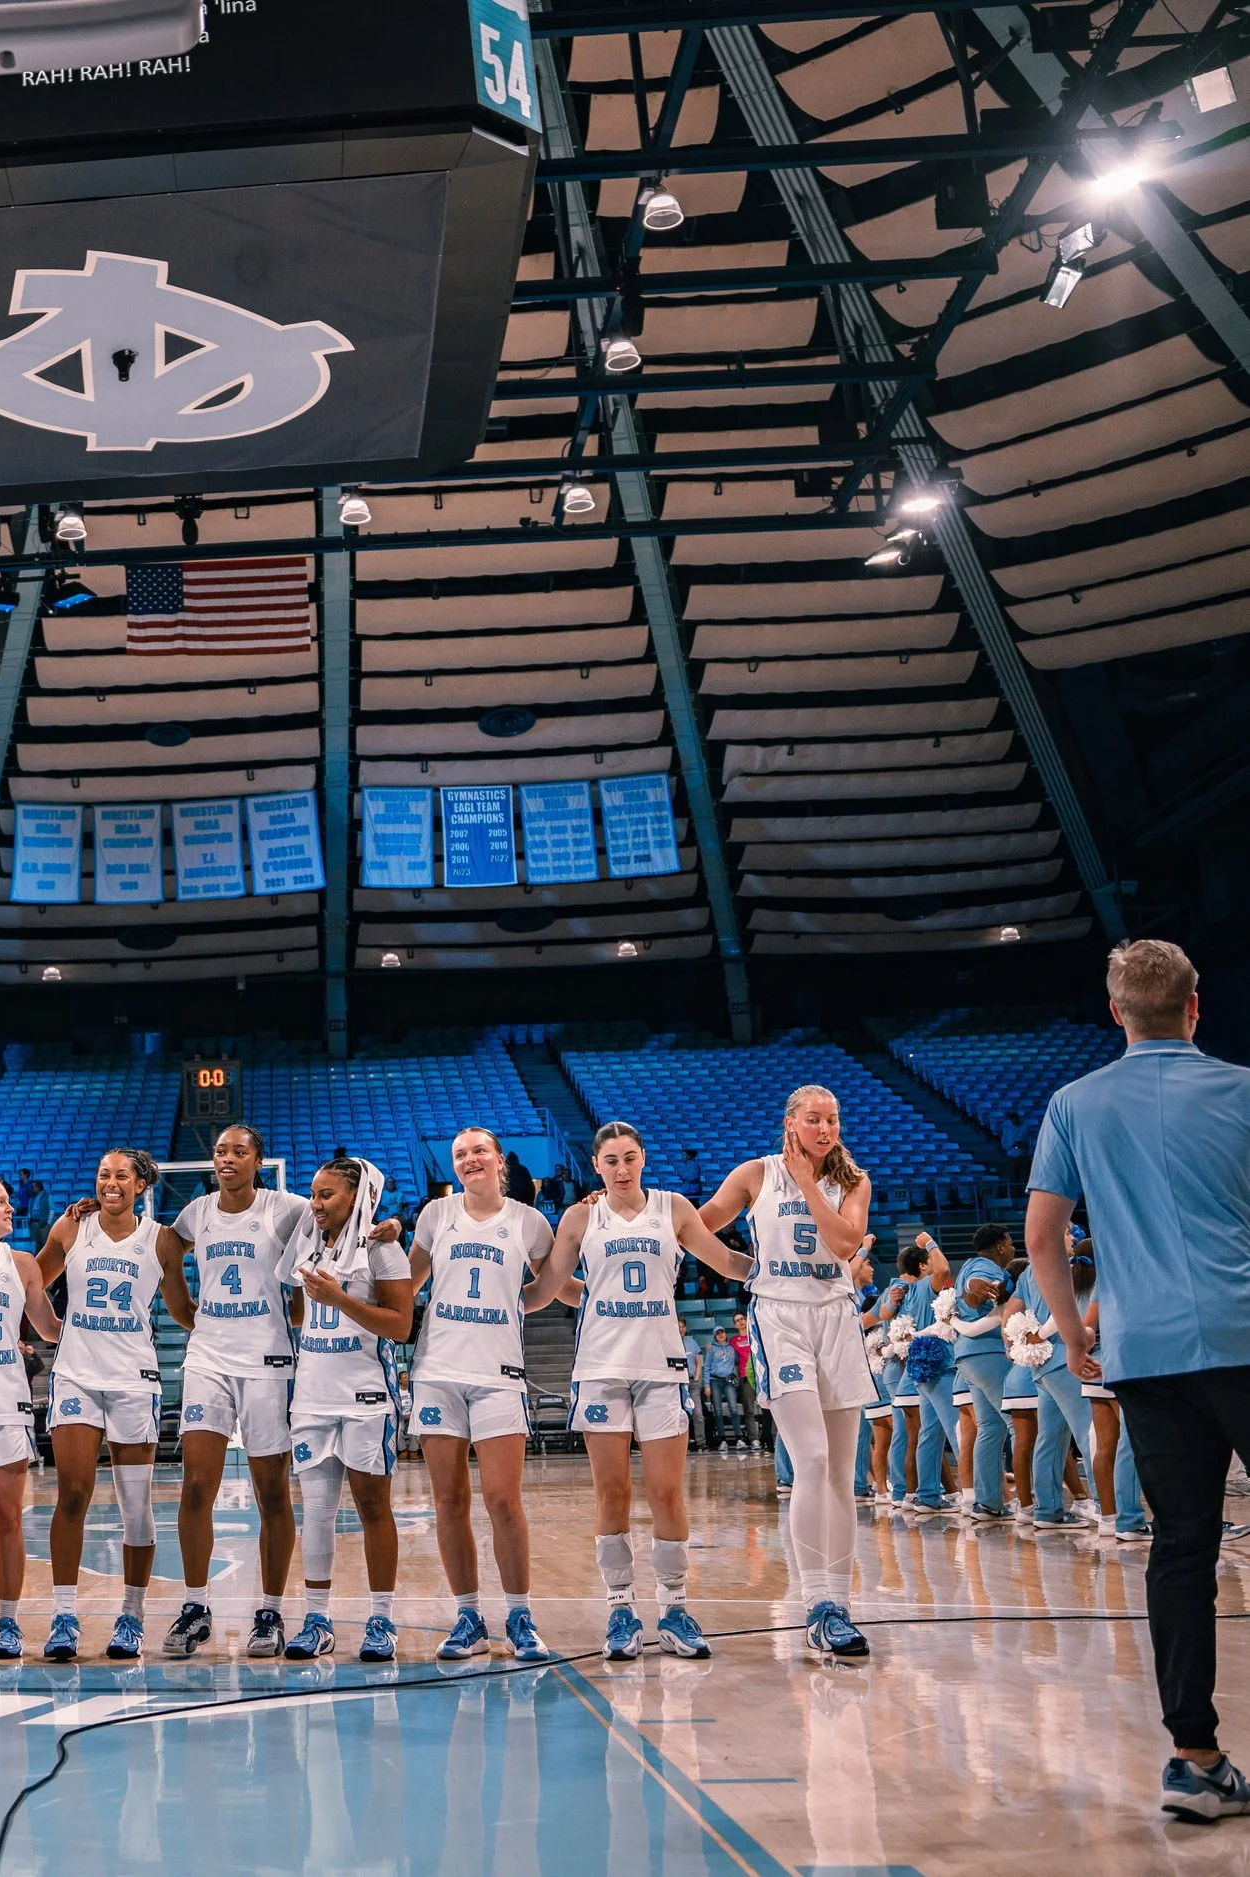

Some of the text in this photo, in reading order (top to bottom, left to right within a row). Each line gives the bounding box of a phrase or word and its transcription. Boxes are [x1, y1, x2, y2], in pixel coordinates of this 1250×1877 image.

[22, 56, 191, 86] RAH! RAH! RAH!
[480, 22, 531, 117] 54
[447, 790, 506, 801] GYMNASTICS
[454, 802, 500, 812] EAGL TEAM
[451, 813, 505, 824] CHAMPIONS
[490, 841, 508, 850] 2010
[452, 856, 469, 864] 2011
[605, 1237, 661, 1257] NORTH
[793, 1222, 818, 1255] 5
[205, 1241, 256, 1260] NORTH
[450, 1242, 505, 1266] NORTH
[86, 1257, 139, 1279] NORTH
[622, 1260, 647, 1294] 0
[221, 1264, 242, 1295] 4
[467, 1267, 481, 1299] 1
[86, 1277, 133, 1311] 24
[201, 1299, 270, 1318] CAROLINA
[310, 1299, 340, 1330] 10
[435, 1301, 510, 1325] CAROLINA
[595, 1300, 671, 1318] CAROLINA
[71, 1311, 144, 1333] CAROLINA
